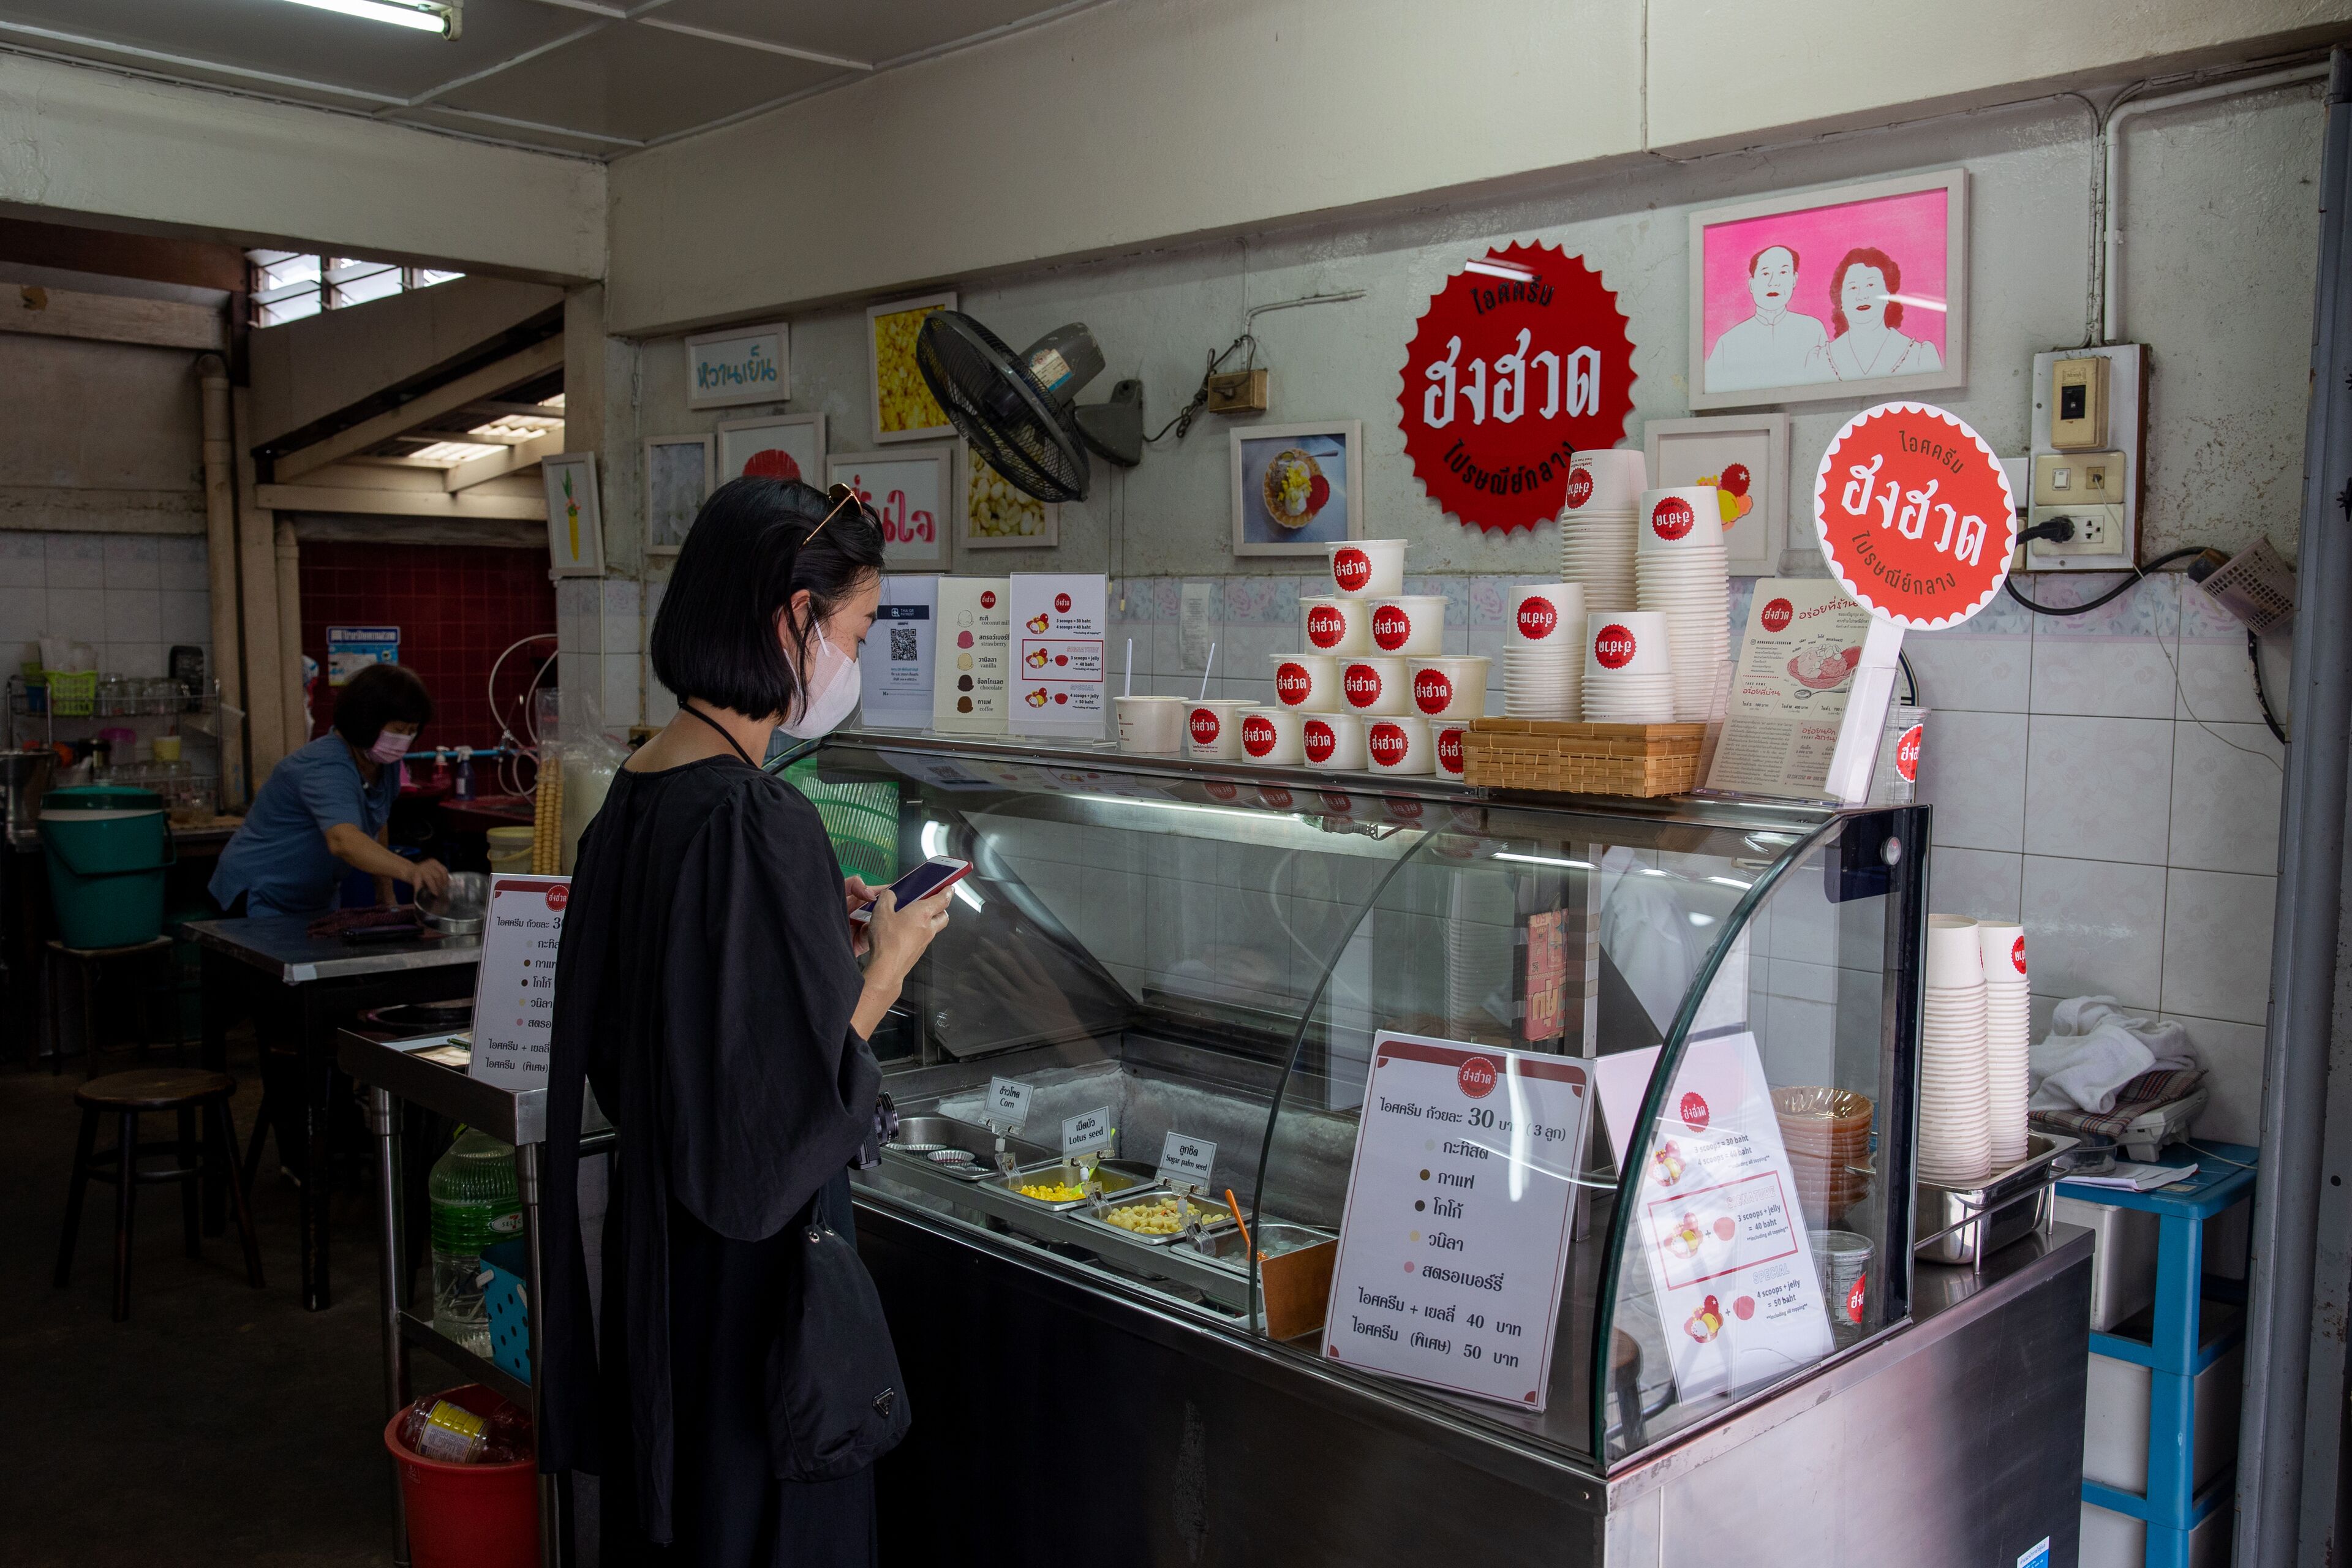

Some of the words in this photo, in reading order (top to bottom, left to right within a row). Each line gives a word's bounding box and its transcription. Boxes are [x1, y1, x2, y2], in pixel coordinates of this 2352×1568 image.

[697, 344, 777, 390] หวานเย็น
[1423, 327, 1601, 429] ฮงฮวด
[1899, 430, 1964, 474] ไอศครีม
[1841, 453, 1988, 567] ฮงฮวด
[1336, 559, 1367, 578] ฮงฮวด
[1851, 530, 1956, 595] ไปรษณีย์กลาง
[1765, 608, 1790, 620] ฮงฮวด
[1799, 596, 1858, 620] อร่อยที่ร้าน
[1310, 616, 1341, 633] ฮงฮวด
[1374, 618, 1406, 635] ฮงฮวด
[1278, 674, 1306, 690] ฮงฮวด
[1346, 676, 1377, 692] ฮงฮวด
[1415, 682, 1447, 698] ฮงฮวด
[1191, 718, 1216, 732] ฮงฮวด
[1245, 728, 1272, 742] ฮงฮวด
[1305, 731, 1332, 747] ฮงฮวด
[1372, 734, 1403, 750] ฮงฮวด
[1441, 740, 1464, 757] ฮงฮว
[497, 916, 524, 928] ไอศครีม
[526, 918, 549, 929] ถ้วยละ
[552, 916, 564, 930] 3
[537, 940, 560, 949] กะทิส
[532, 976, 552, 989] โกโก้
[530, 998, 552, 1009] วนิลา
[488, 1038, 518, 1051] ไอศครีม
[530, 1041, 551, 1054] เยลลี่
[486, 1057, 516, 1070] ไอศครีม
[522, 1059, 549, 1074] (พิเศษ)
[999, 1085, 1020, 1099] ข้าวโพด
[1000, 1098, 1015, 1109] Corn
[1379, 1096, 1422, 1118] ไอศครีม
[1426, 1105, 1463, 1125] ถ้วยละ
[1468, 1106, 1494, 1129] 30
[1076, 1118, 1096, 1132] เม็ดบัว
[1069, 1133, 1087, 1145] Lotus
[1088, 1128, 1104, 1141] seed
[1700, 1142, 1721, 1154] scoops
[1734, 1134, 1749, 1145] baht
[1179, 1144, 1199, 1157] ลูกชิด
[1443, 1140, 1488, 1160] กะทิสด
[1703, 1153, 1725, 1166] scoops
[1730, 1150, 1738, 1159] 40
[1738, 1147, 1752, 1157] baht
[1166, 1154, 1180, 1166] Sugar
[1180, 1159, 1194, 1169] palm
[1195, 1163, 1208, 1171] seed
[1438, 1169, 1475, 1190] กาแฟ
[1726, 1186, 1777, 1210] SIGNATURE
[1433, 1197, 1463, 1219] โกโก้
[1742, 1210, 1763, 1223] scoops
[1768, 1204, 1781, 1216] jelly
[502, 1218, 521, 1227] SELEC
[1762, 1218, 1777, 1229] baht
[1428, 1231, 1464, 1252] วนิลา
[1422, 1264, 1505, 1293] สตรอเบอร์รี่
[1752, 1263, 1790, 1284] SPECIAL
[1762, 1285, 1783, 1298] scoops
[1787, 1279, 1801, 1291] jelly
[1774, 1298, 1782, 1308] 50
[1781, 1293, 1797, 1305] baht
[1358, 1286, 1405, 1313] ไอศครีม
[1423, 1303, 1456, 1324] เยลลี่
[1466, 1313, 1485, 1329] 40
[1496, 1320, 1522, 1338] บาท
[1352, 1315, 1399, 1343] ไอศครีม
[1410, 1332, 1452, 1355] (พิเศษ)
[1463, 1344, 1482, 1360] 50
[1493, 1351, 1519, 1368] บาท
